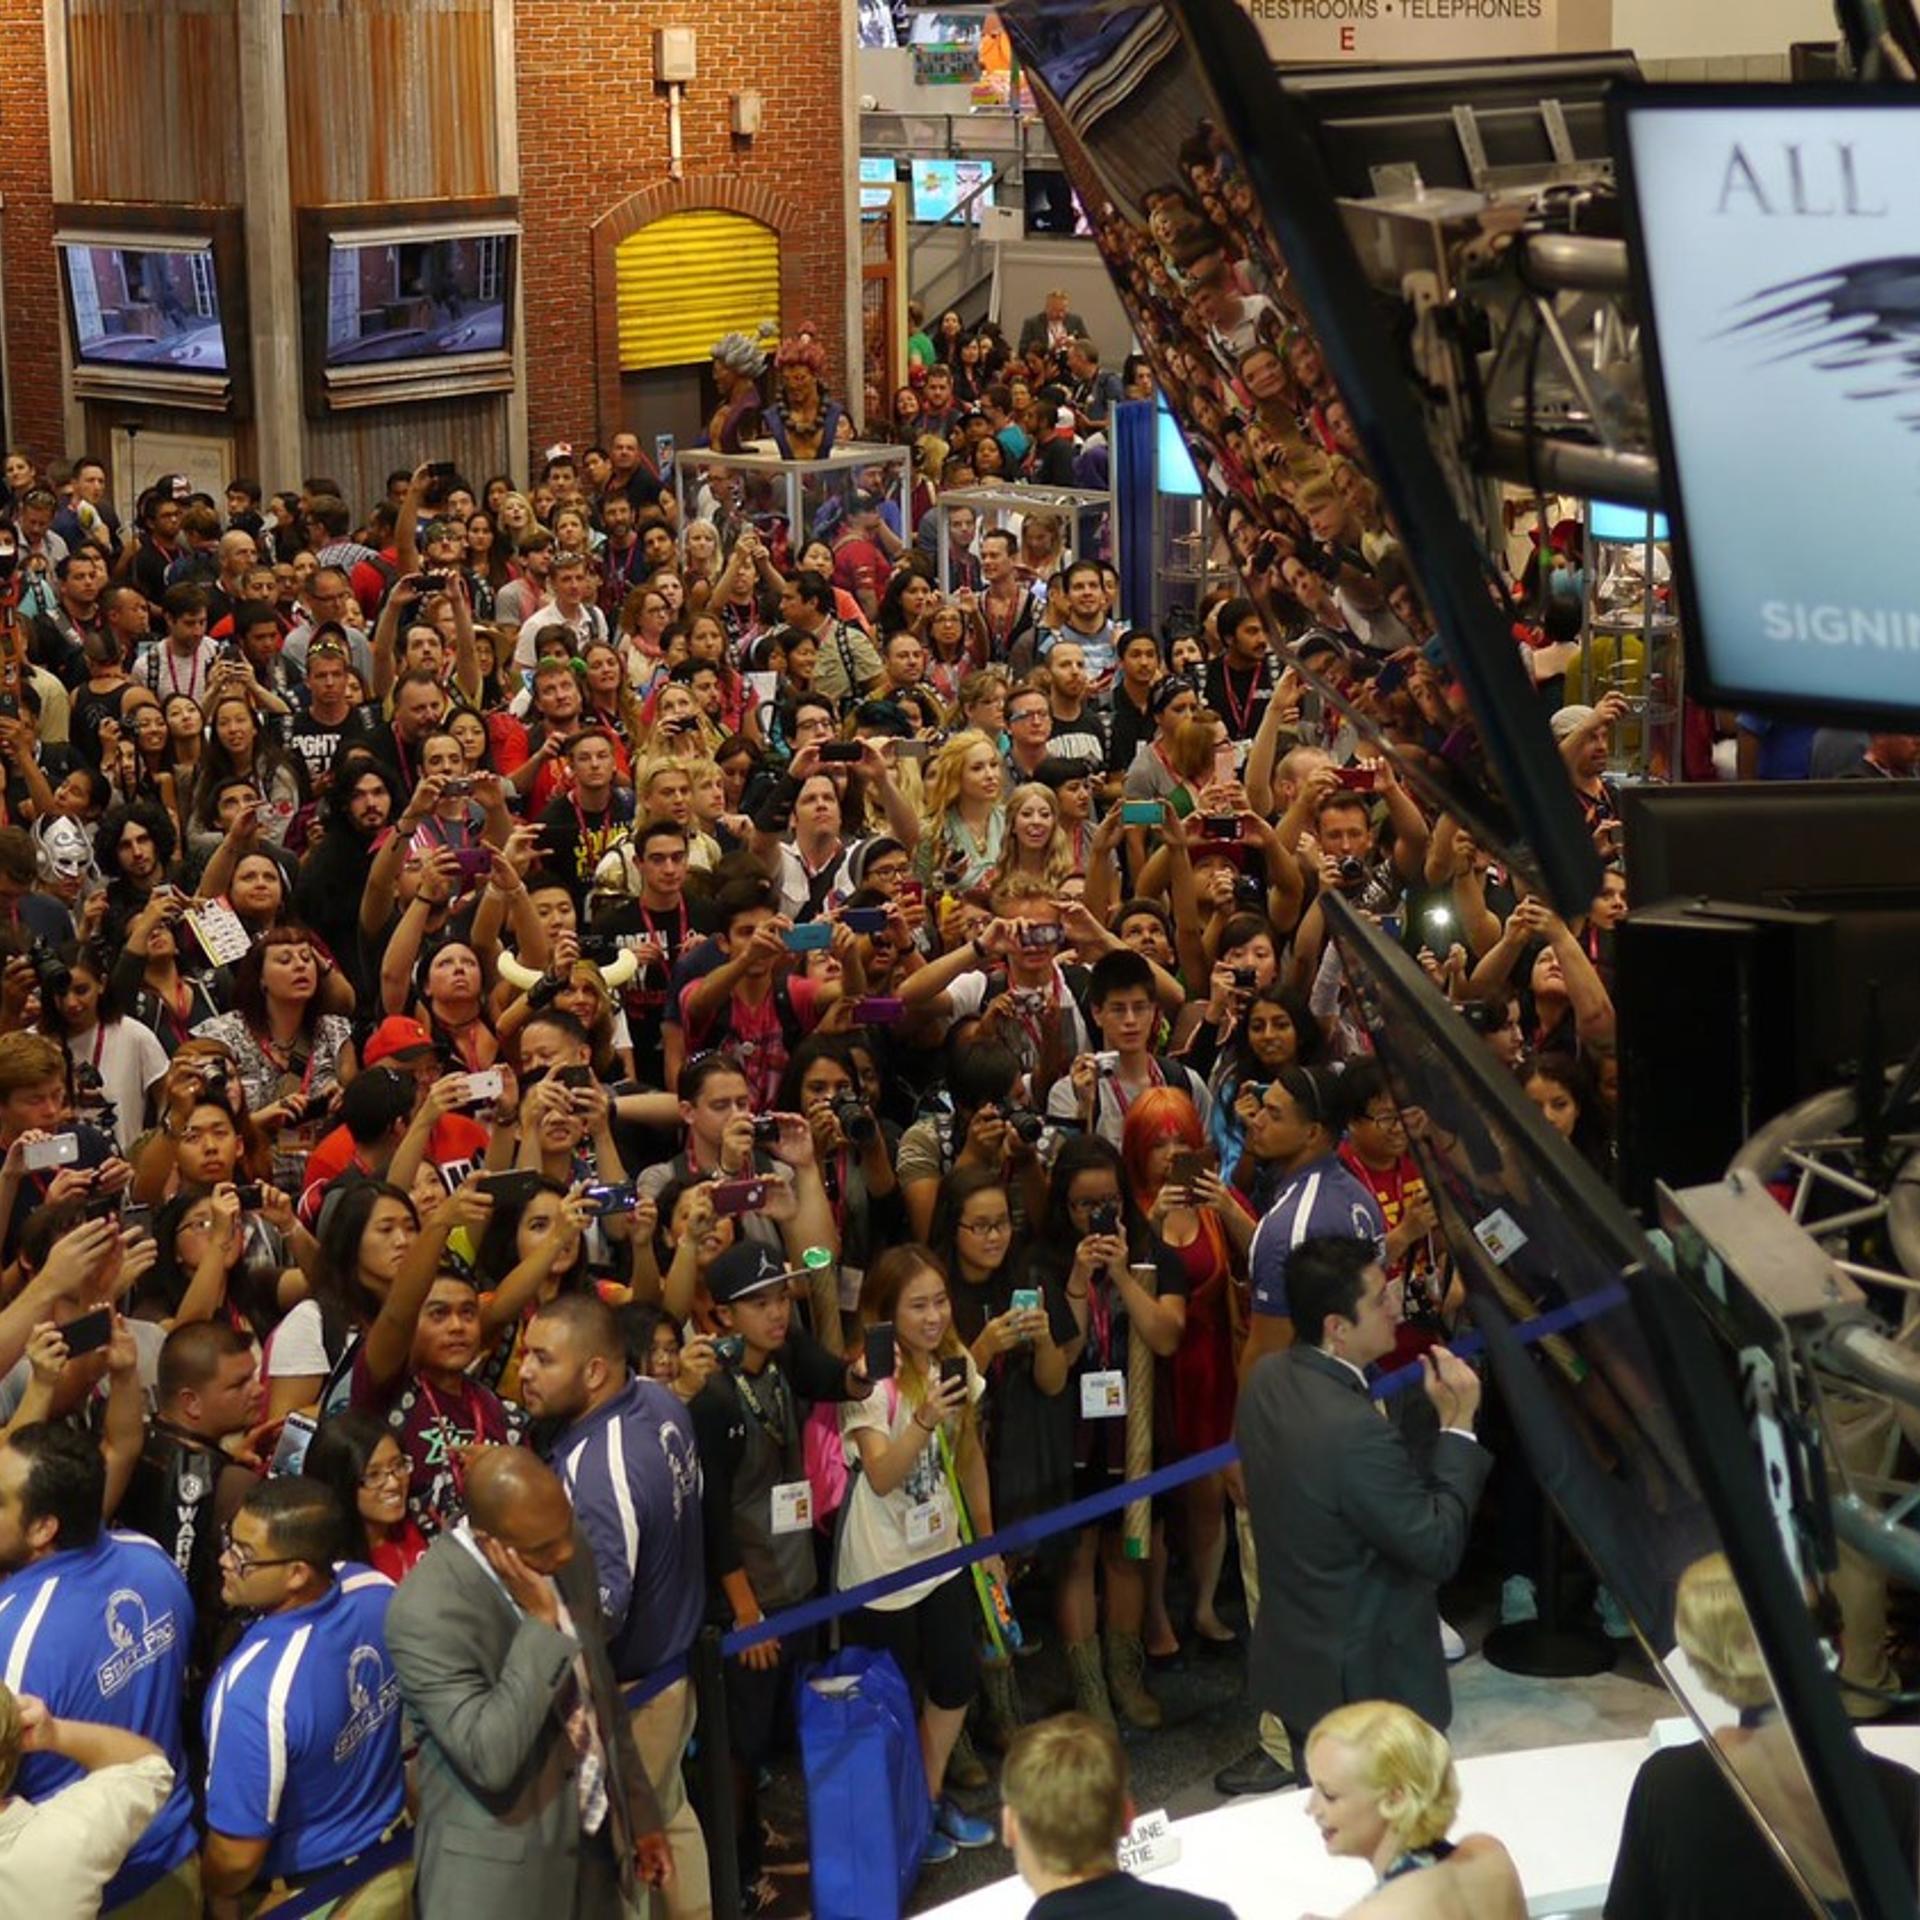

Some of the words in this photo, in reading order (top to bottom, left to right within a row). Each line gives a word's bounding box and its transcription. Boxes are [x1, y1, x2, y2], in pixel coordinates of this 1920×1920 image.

[1250, 0, 1378, 19] RESTROOMS
[1401, 0, 1542, 19] TELEPHONES
[1340, 27, 1355, 50] E
[1710, 142, 1888, 216] ALL
